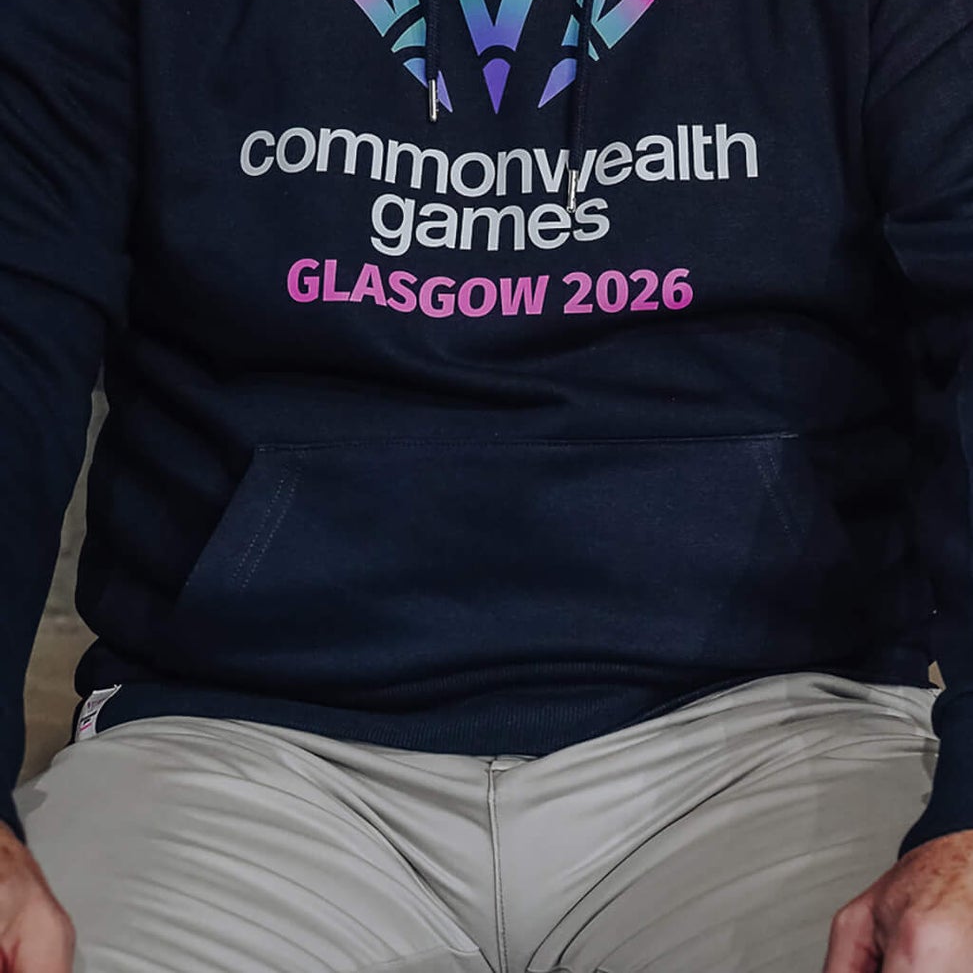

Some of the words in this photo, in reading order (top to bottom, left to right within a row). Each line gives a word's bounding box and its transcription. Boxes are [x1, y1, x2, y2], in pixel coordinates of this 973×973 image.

[240, 123, 759, 197] commonwealth
[370, 193, 610, 256] games
[287, 258, 549, 318] GLASGOW
[563, 268, 694, 314] 2026
